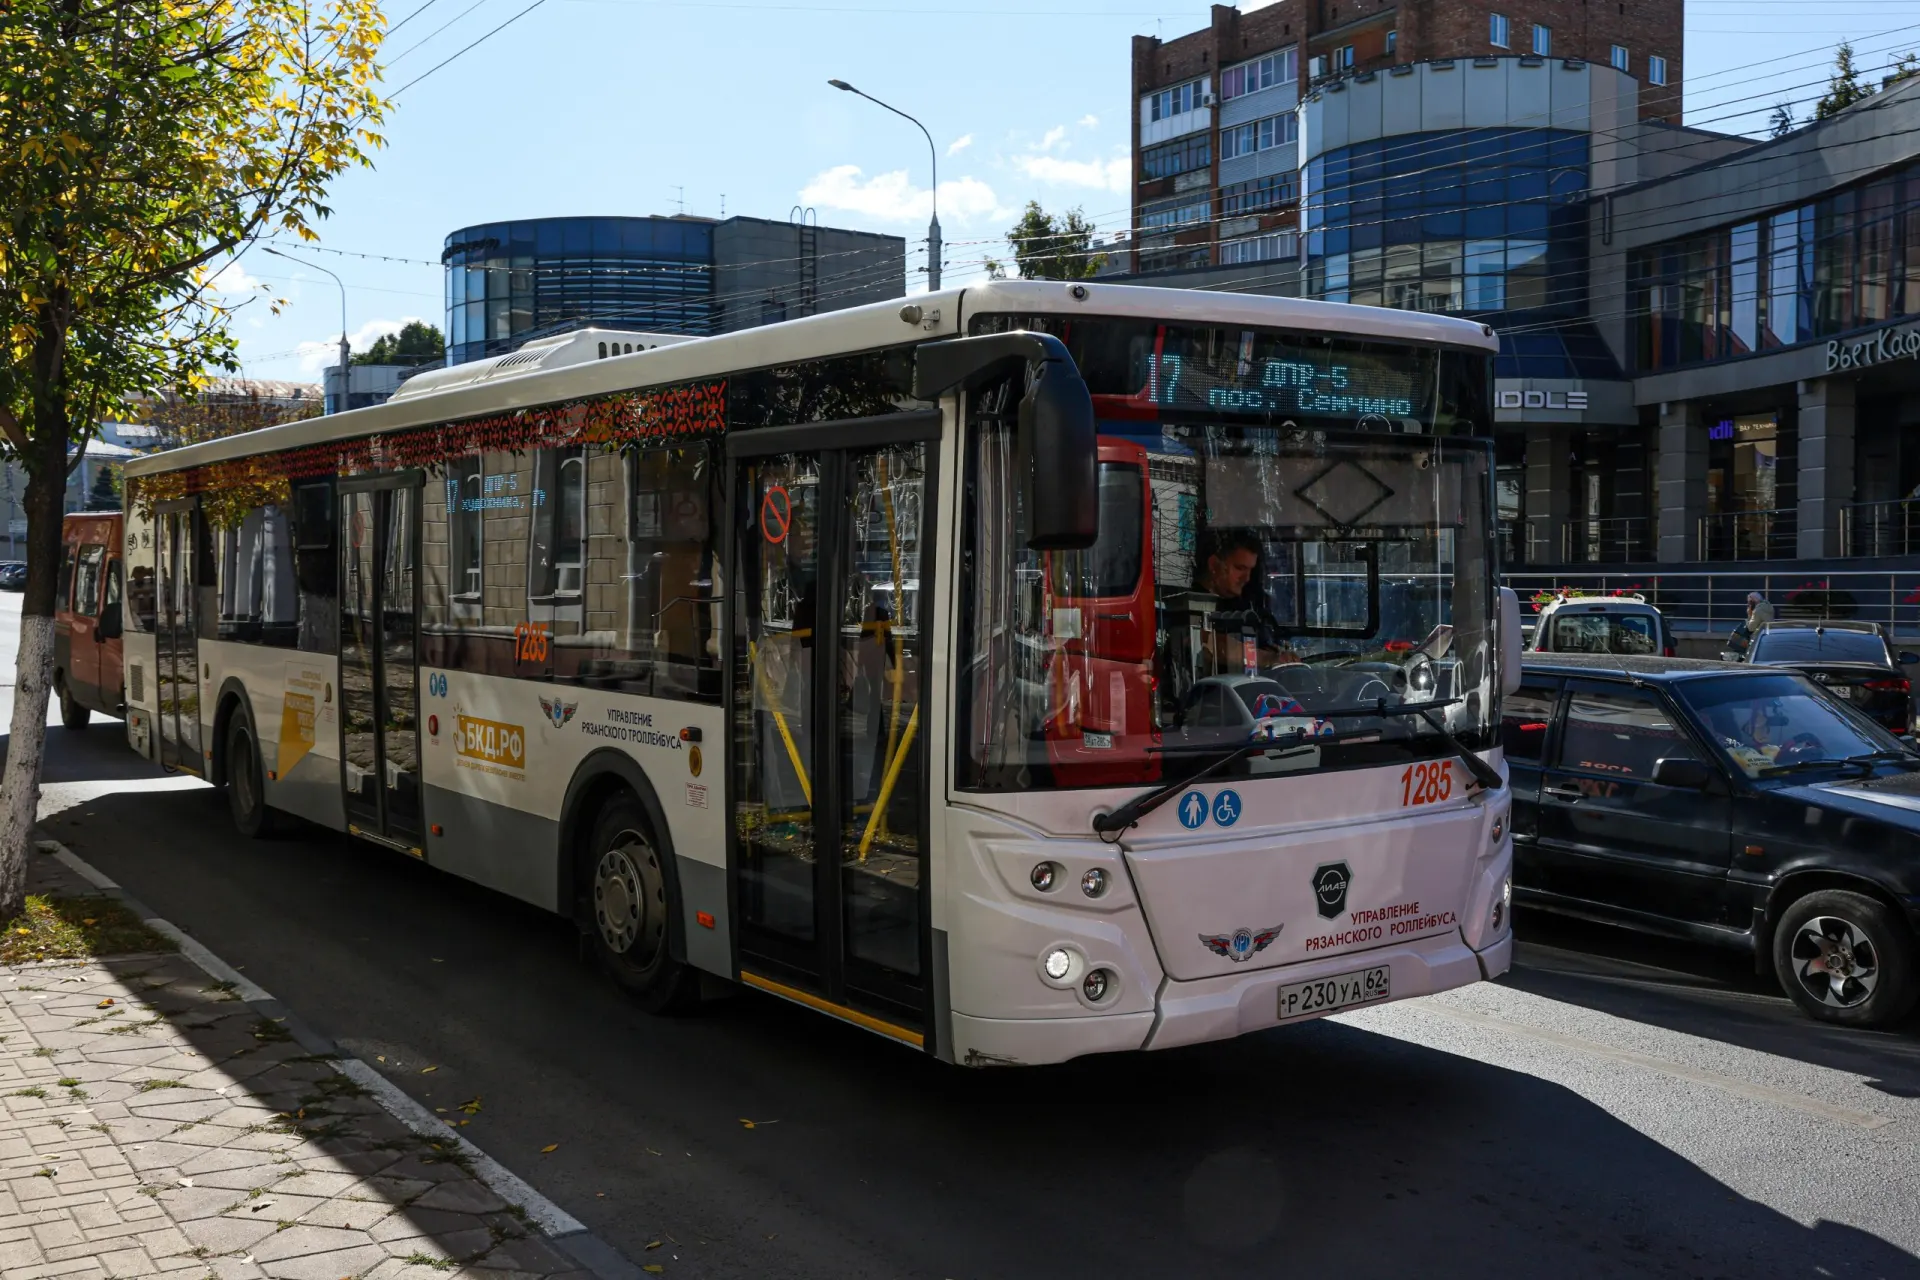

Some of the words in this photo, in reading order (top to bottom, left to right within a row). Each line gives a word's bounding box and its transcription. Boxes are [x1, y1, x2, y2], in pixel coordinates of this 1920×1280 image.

[1149, 354, 1180, 403] 17
[1262, 361, 1348, 388] ДПР-5
[1209, 389, 1276, 408] пос.
[1298, 388, 1411, 415] Семчино
[446, 479, 459, 513] 17
[484, 474, 518, 494] ДПР-5
[513, 621, 548, 663] 1285
[606, 708, 653, 727] УПРАВЛЕНИЕ
[466, 722, 523, 761] БКД.РФ
[581, 721, 628, 741] РЯЗАНСКОГО
[628, 729, 682, 750] ТРОЛЛЕЙБУСА
[1401, 760, 1453, 807] 1285
[1317, 880, 1347, 893] ЛИАЗ
[1351, 901, 1420, 925] УПРАВЛЕНИЕ
[1305, 925, 1382, 952] РЯЗАНСКОГО
[1390, 912, 1457, 937] РОЛЛЕЙБУСА
[1287, 980, 1362, 1014] Р230УА
[1366, 969, 1384, 990] 62
[1365, 990, 1378, 998] RUS
